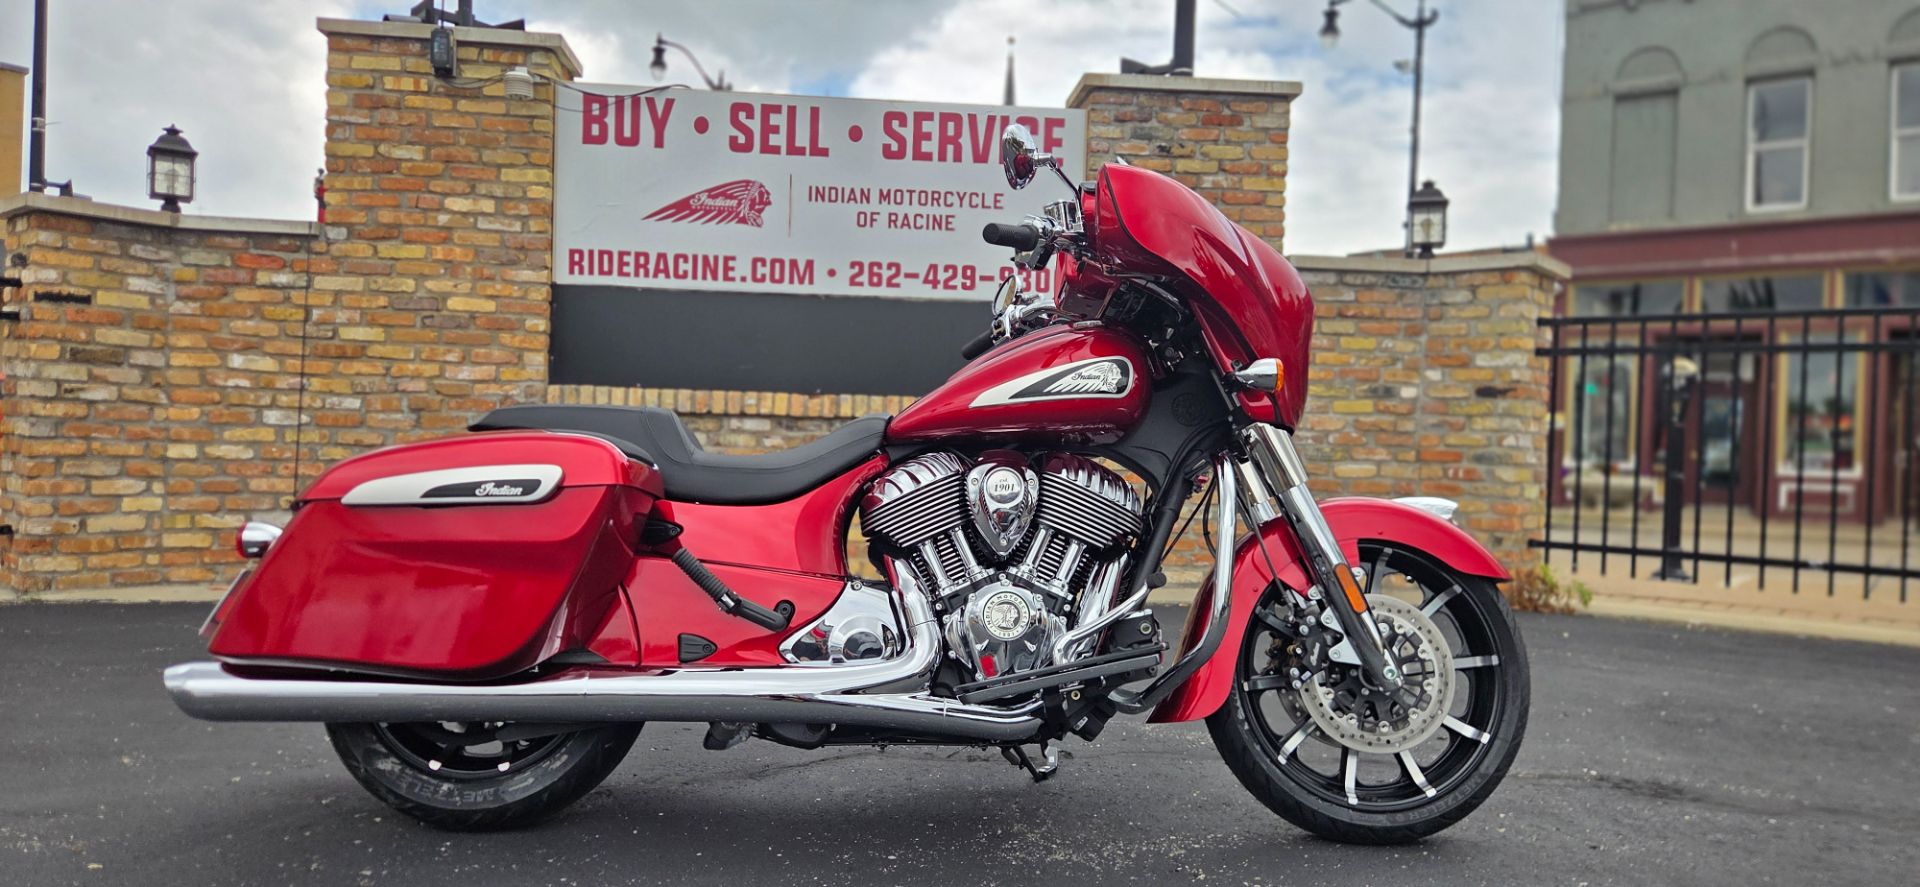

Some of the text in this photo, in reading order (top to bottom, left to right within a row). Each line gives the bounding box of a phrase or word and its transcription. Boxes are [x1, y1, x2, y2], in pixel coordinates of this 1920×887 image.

[582, 92, 676, 149] BUY
[728, 101, 830, 157] SELL
[690, 191, 738, 206] Indian
[808, 185, 1005, 210] INDIAN MOTORCYCLE
[856, 211, 956, 231] OF RACINE
[568, 247, 815, 286] RIDERACINE.COM
[1071, 371, 1101, 381] Indian
[475, 482, 523, 497] Indian
[994, 483, 1015, 492] 1901
